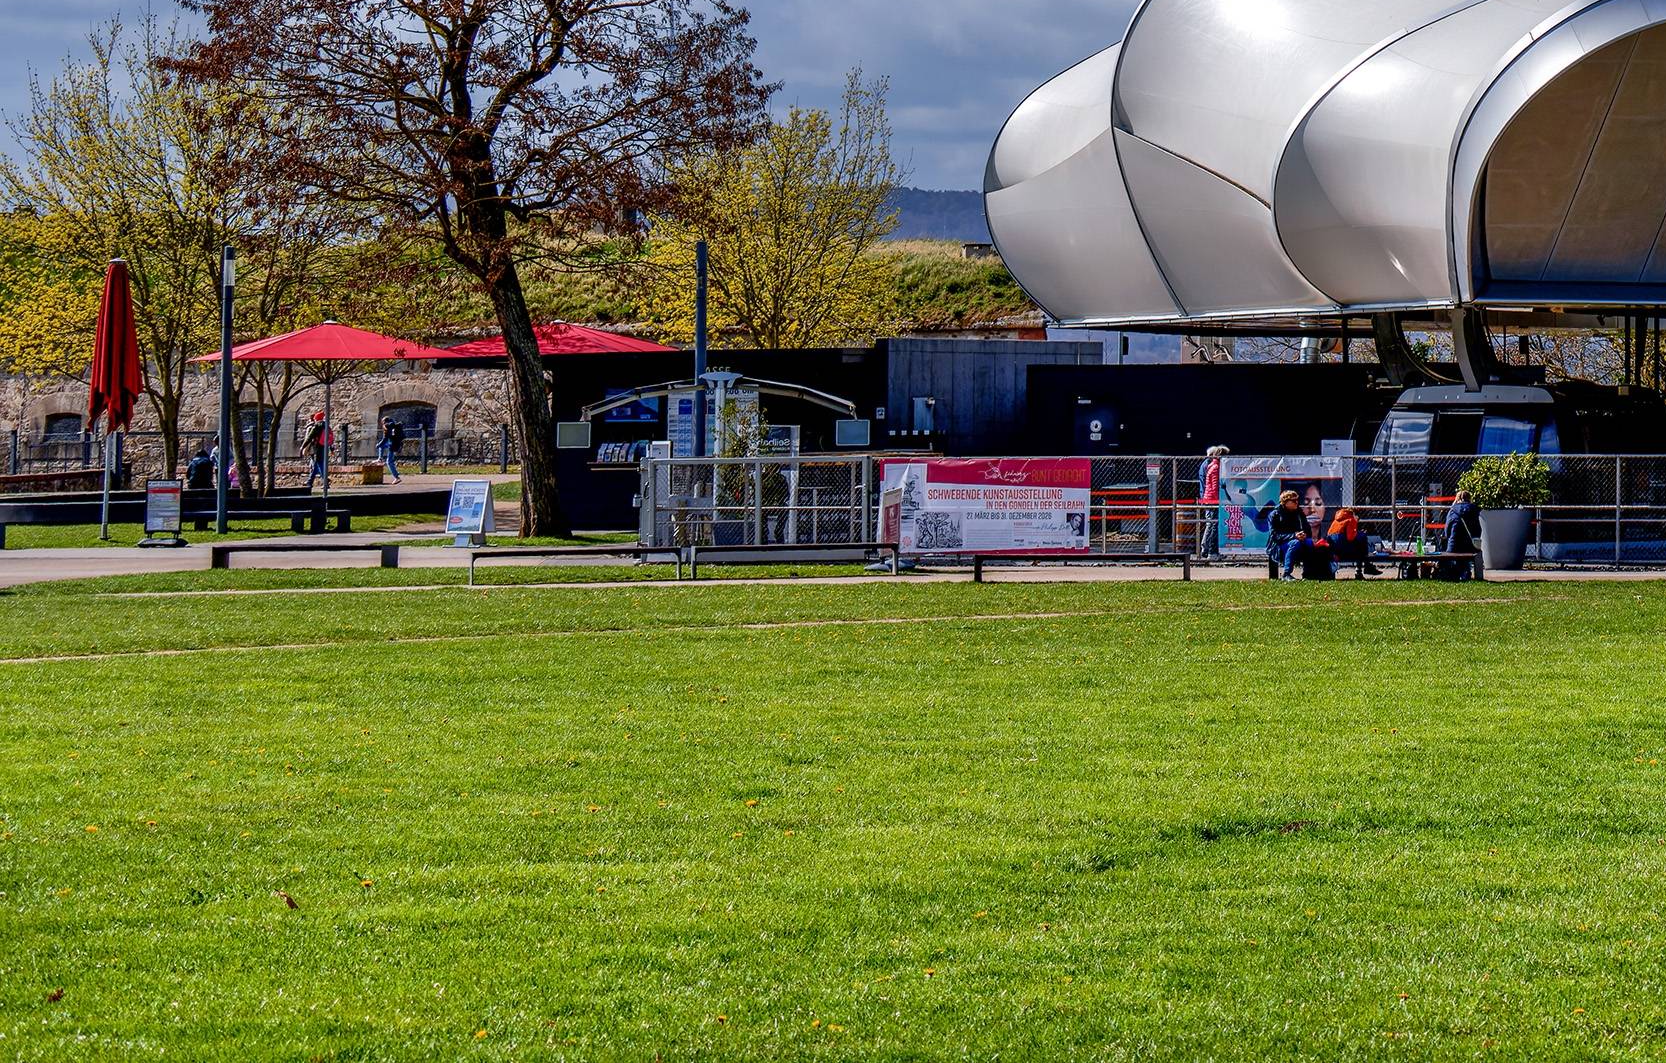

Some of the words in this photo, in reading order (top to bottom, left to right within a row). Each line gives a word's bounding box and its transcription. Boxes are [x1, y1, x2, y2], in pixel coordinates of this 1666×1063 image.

[928, 489, 981, 500] SCHWEBENDE
[983, 489, 1063, 501] KUNSTAUSSTELLUNG
[986, 501, 994, 509] IN
[995, 501, 1008, 510] DEN
[1009, 501, 1039, 510] GONDELN
[1040, 501, 1053, 510] DER
[1054, 501, 1085, 510] SEILBAHN
[974, 511, 990, 520] MÄRZ
[990, 512, 1000, 520] BIS
[1008, 512, 1037, 520] DEZEMBER
[1230, 512, 1244, 520] AUS
[1230, 526, 1242, 534] TEN
